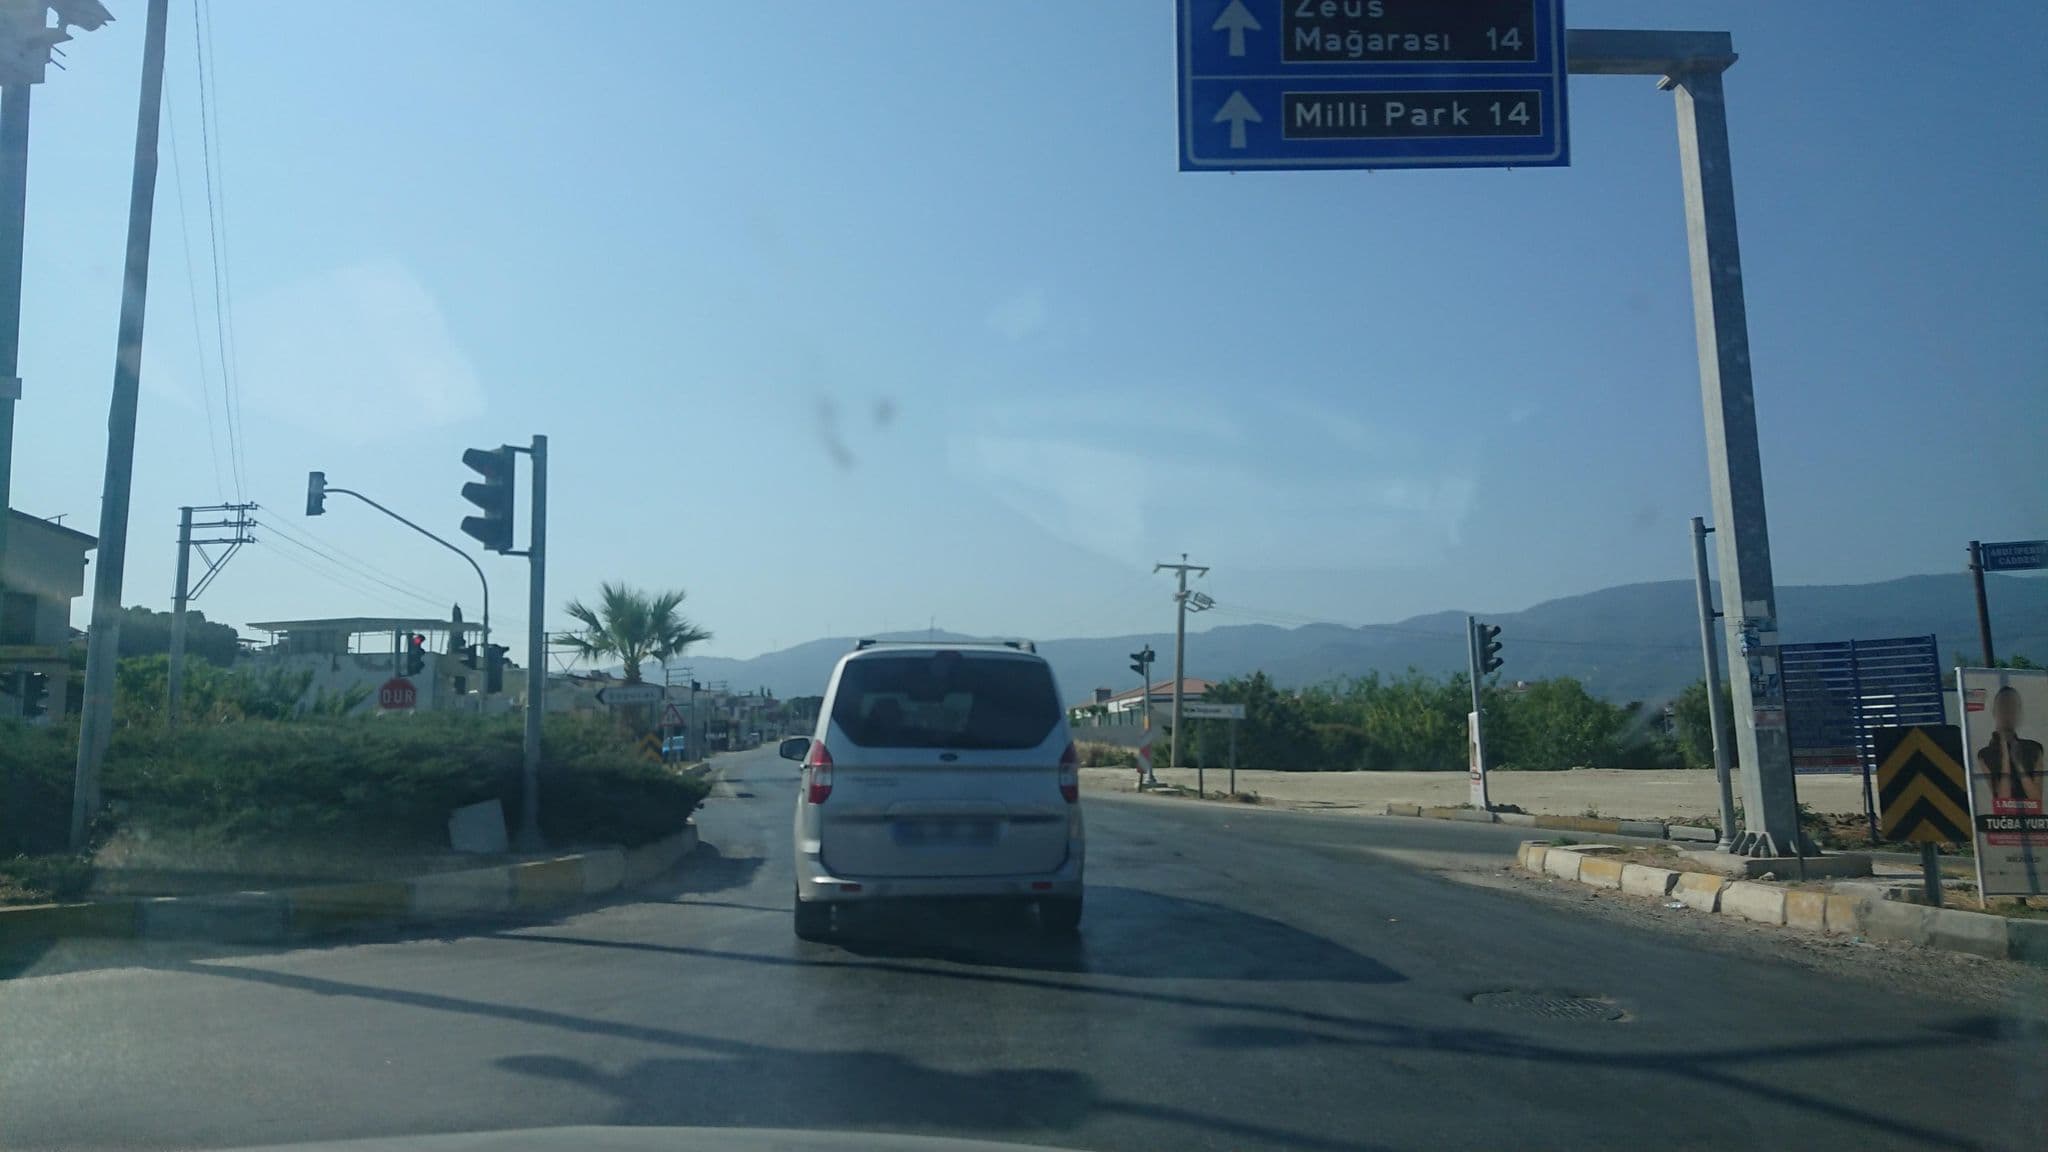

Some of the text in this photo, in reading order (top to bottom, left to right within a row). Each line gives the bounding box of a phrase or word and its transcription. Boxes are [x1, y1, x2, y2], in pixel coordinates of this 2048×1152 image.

[1295, 0, 1384, 18] Zeus
[1295, 26, 1523, 57] Mağarası 14
[1295, 101, 1530, 127] Milli Park 14
[382, 689, 414, 704] DUR
[1986, 816, 2021, 830] TUĞBA
